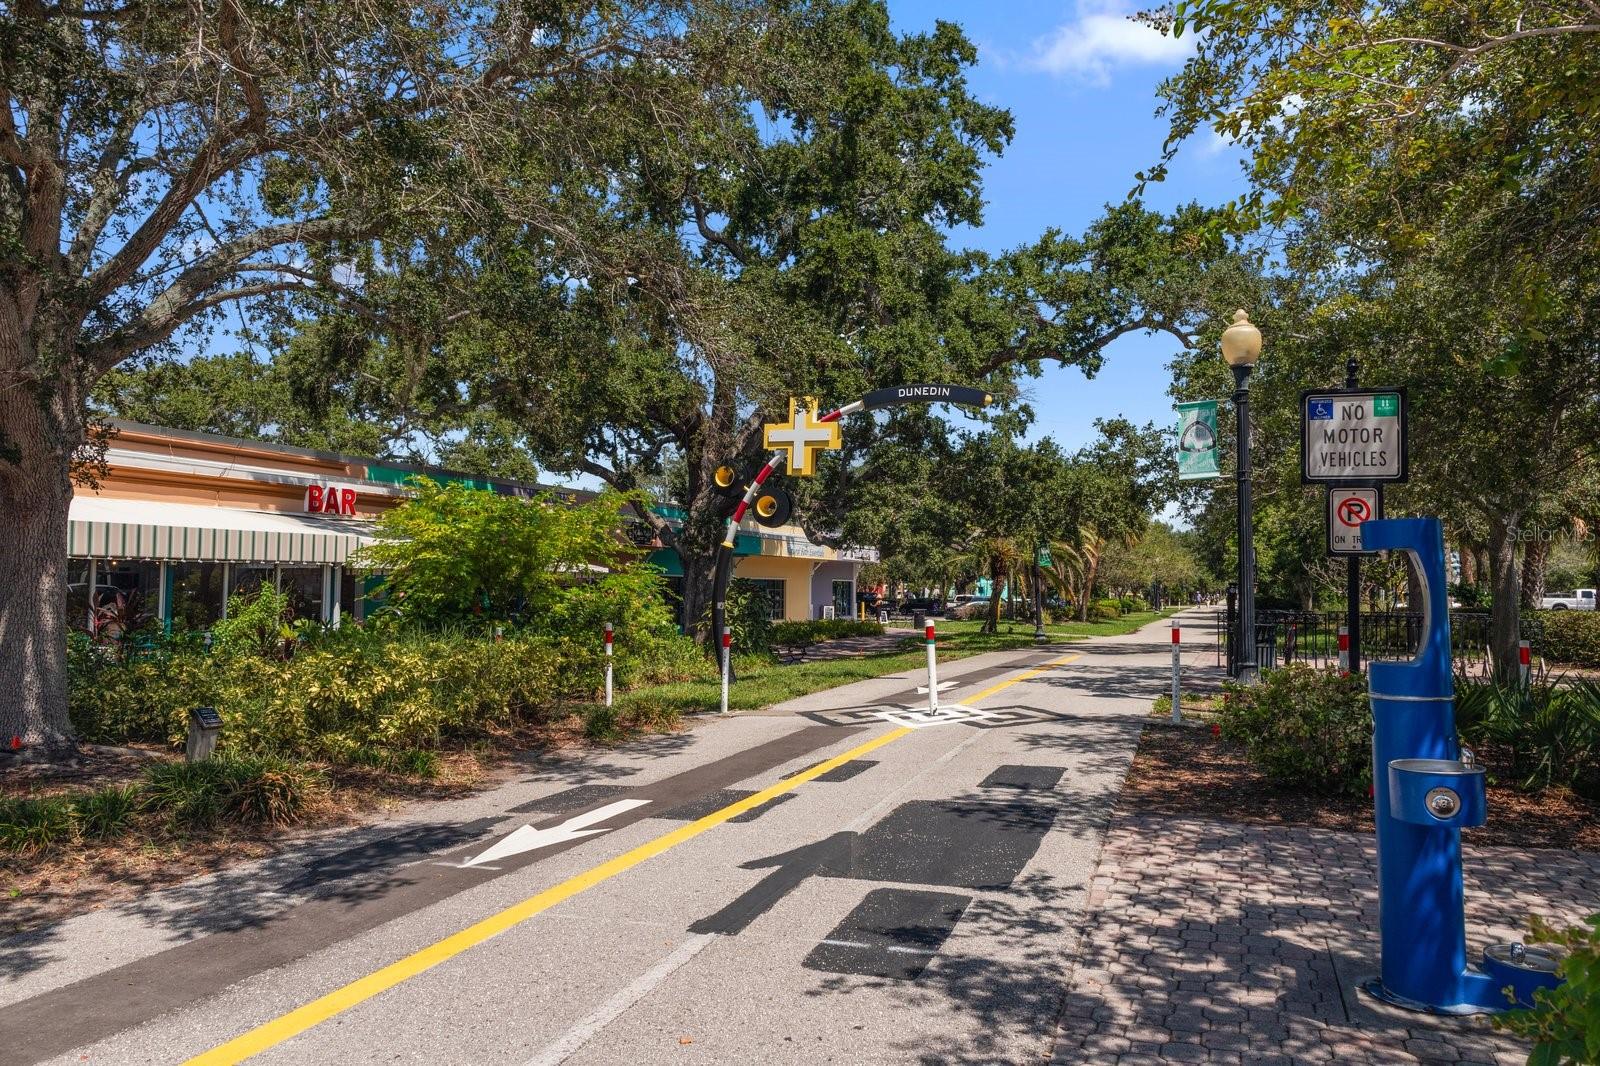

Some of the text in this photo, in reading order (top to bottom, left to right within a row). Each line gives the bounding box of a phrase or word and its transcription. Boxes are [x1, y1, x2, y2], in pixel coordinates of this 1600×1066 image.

[898, 386, 950, 398] DUNEDIN
[1342, 404, 1364, 421] NO
[1323, 428, 1383, 445] MOTOR
[1320, 450, 1387, 468] VEHICLES
[306, 485, 357, 515] BAR
[1334, 535, 1346, 544] ON
